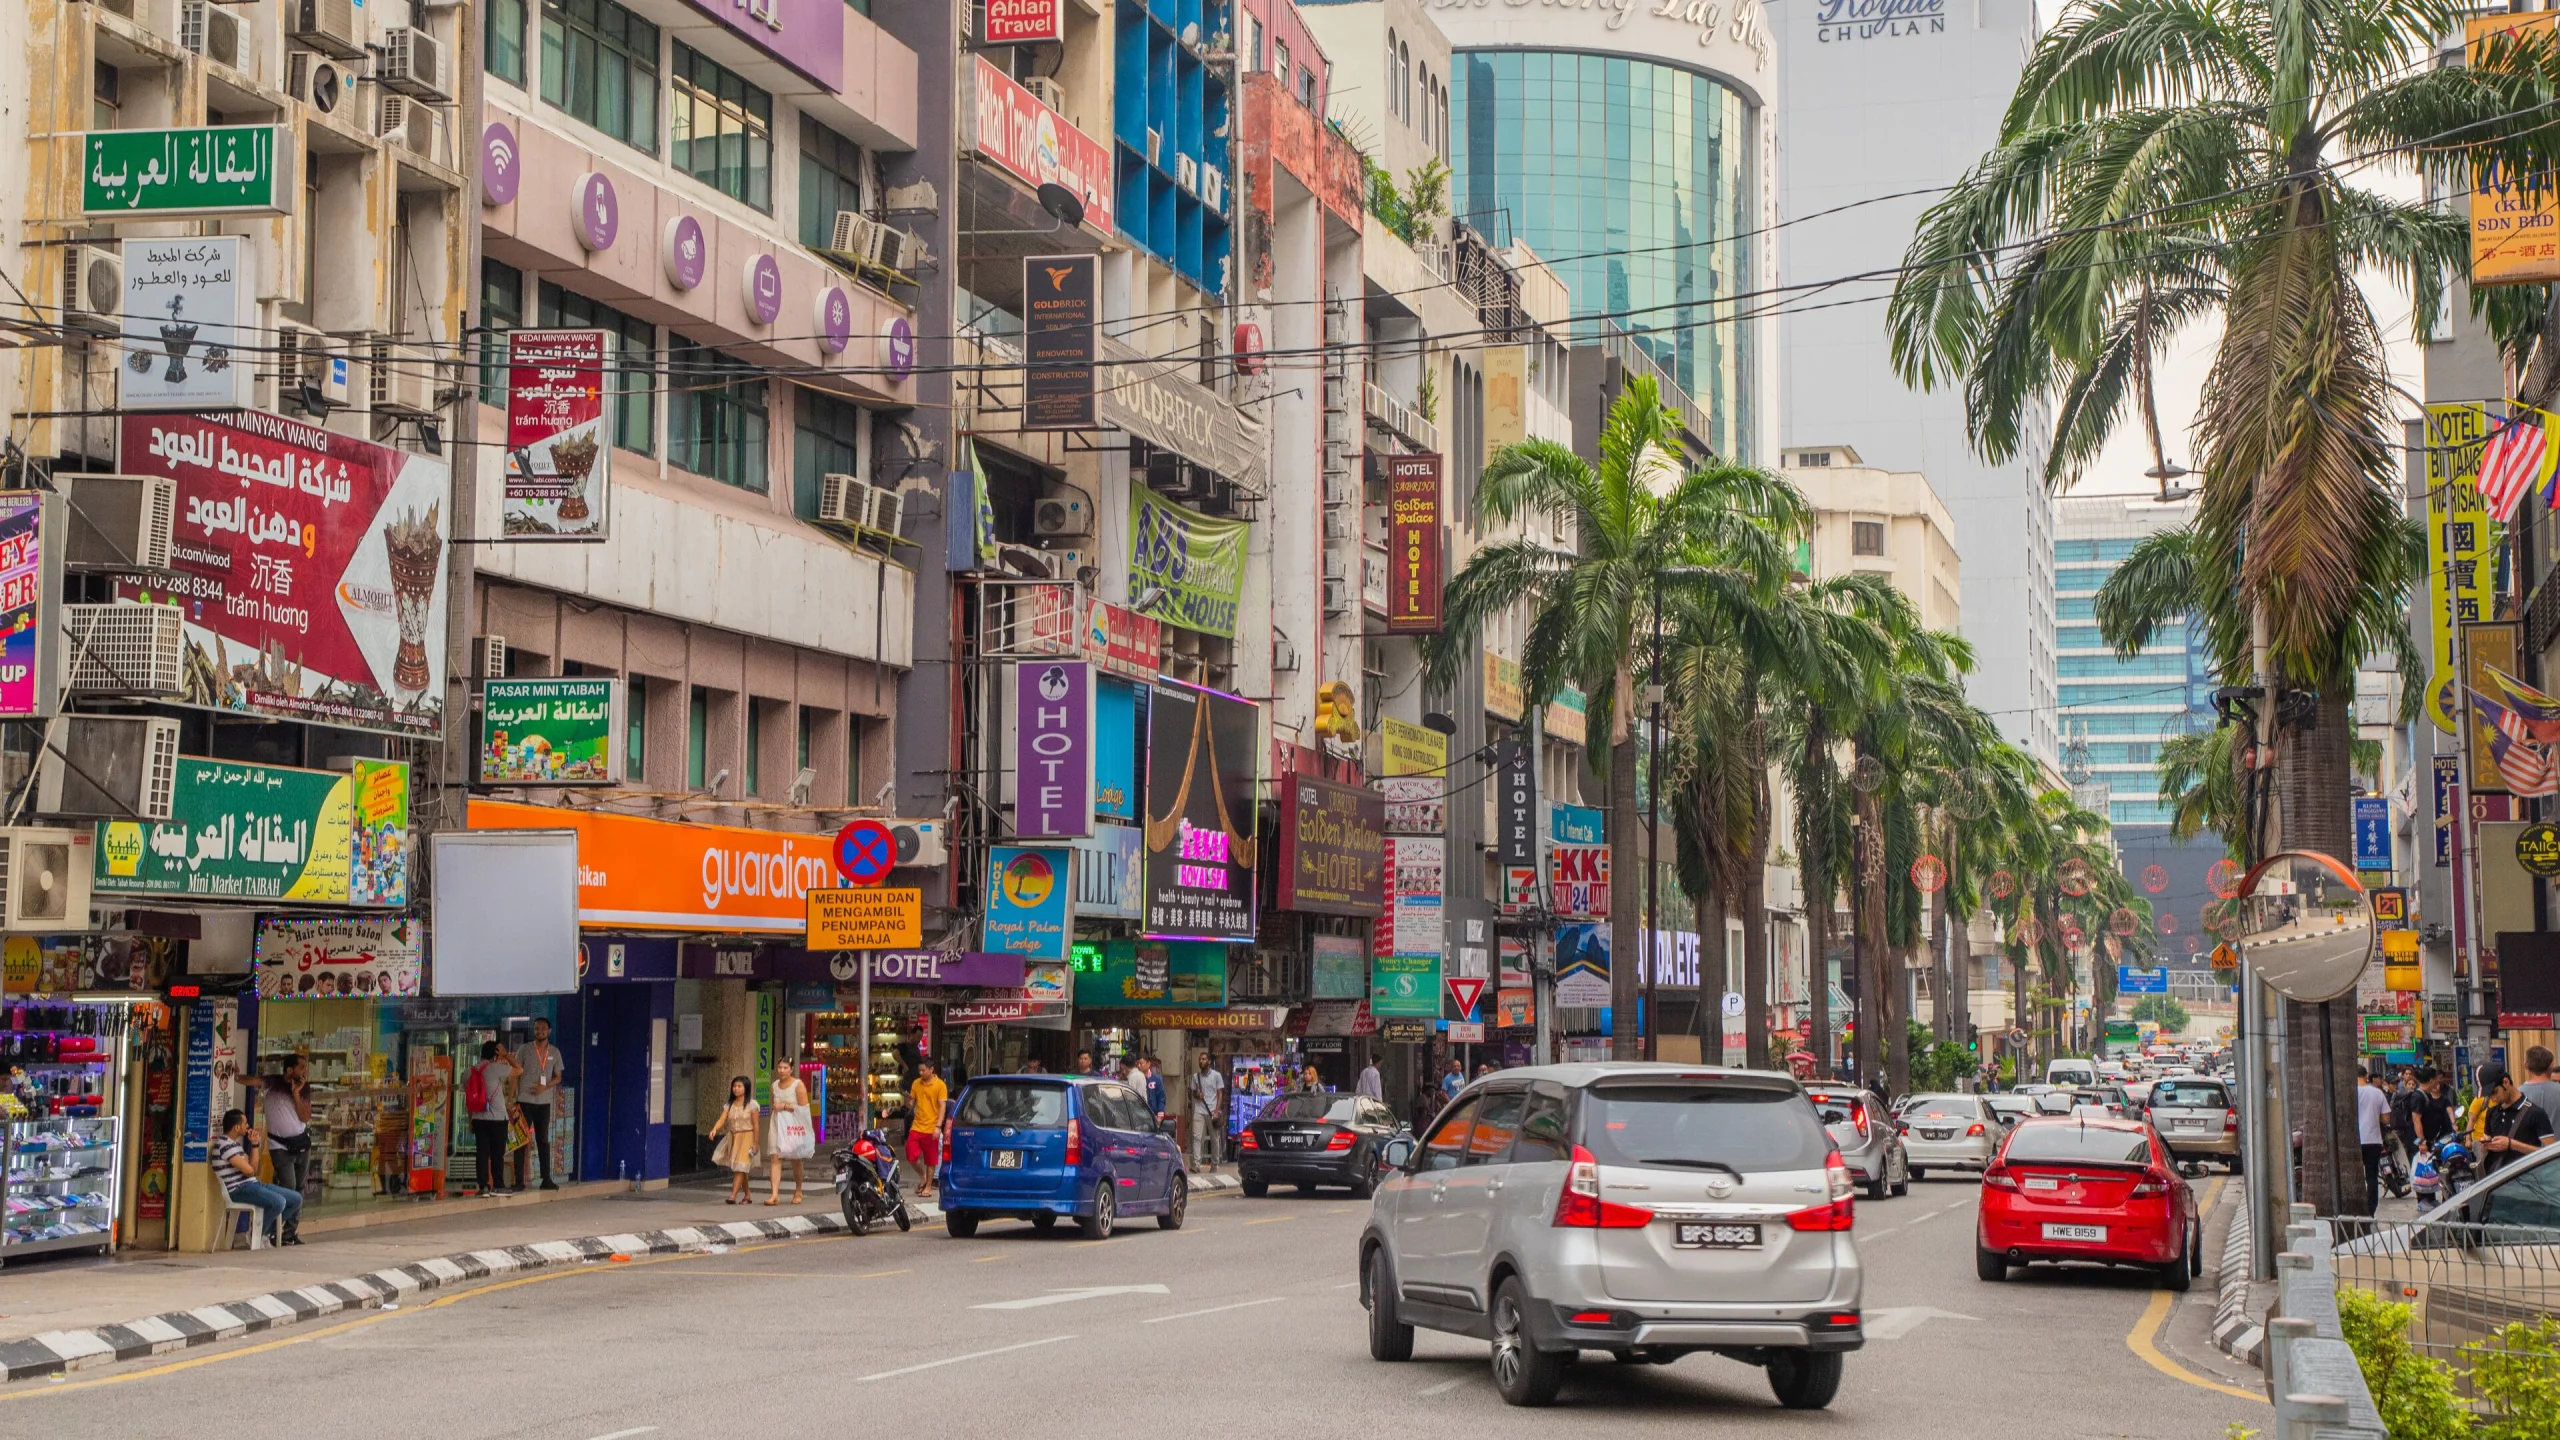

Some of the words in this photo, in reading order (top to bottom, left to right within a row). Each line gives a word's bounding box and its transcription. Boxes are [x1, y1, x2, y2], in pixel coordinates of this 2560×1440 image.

[991, 16, 1051, 34] Travel
[978, 67, 1005, 158] Ahlan
[1007, 86, 1038, 179] Travel
[92, 132, 178, 208] العربية
[189, 129, 265, 195] البقالة
[2477, 217, 2511, 231] SDN
[2518, 214, 2554, 229] BHD
[147, 247, 181, 266] المحيط
[184, 245, 221, 266] شركة
[2480, 243, 2556, 260] 第一酒店
[192, 269, 231, 289] للعود
[1034, 300, 1087, 309] GOLDBRICK
[1034, 312, 1086, 320] INTERNATIONAL
[519, 334, 540, 342] KEDAI
[542, 334, 570, 342] MINYAK
[1036, 350, 1084, 358] RENOVATION
[1031, 371, 1089, 380] CONSTRUCTION
[544, 400, 570, 414] 沉香
[1112, 364, 1214, 450] GOLDBRICK
[236, 411, 285, 441] MINYAK
[287, 423, 328, 453] WANGI
[2430, 411, 2480, 443] HOTEL
[149, 427, 214, 470] للعود
[217, 435, 295, 489] المحيط
[1396, 463, 1433, 476] HOTEL
[298, 458, 351, 508] شركة
[509, 489, 523, 497] +60
[550, 489, 568, 497] 8344
[1393, 481, 1435, 493] SABRINA
[1393, 499, 1435, 511] Golden
[186, 496, 246, 537] العود
[1395, 513, 1434, 527] Palace
[1132, 501, 1191, 584] ABS
[250, 552, 293, 597] 沉香
[1184, 556, 1236, 596] BINTANG
[1408, 529, 1421, 612] HOTEL
[193, 577, 223, 601] 8344
[351, 587, 394, 608] ALMOHIT
[263, 596, 309, 634] hương
[1182, 592, 1236, 632] HOUSE
[491, 685, 530, 697] PASAR
[532, 684, 559, 696] MINI
[561, 684, 605, 696] TAIBAH
[288, 696, 310, 710] Almohit
[310, 700, 330, 715] Trading
[487, 701, 548, 727] العربية
[553, 700, 609, 726] البقالة
[403, 715, 418, 726] LESEN
[1032, 706, 1072, 835] HOTEL
[2434, 760, 2457, 770] HOTE
[196, 766, 221, 787] الرحيم
[223, 769, 251, 786] الرحمن
[253, 770, 265, 784] الله
[267, 774, 283, 792] بسم
[1096, 780, 1126, 811] Lodge
[1300, 786, 1319, 806] HOTEL
[1513, 773, 1526, 857] HOTEL
[1298, 808, 1341, 847] Golden
[238, 811, 307, 878] البقالة
[702, 840, 827, 910] guardian
[1316, 852, 1365, 892] HOTEL
[1561, 849, 1601, 881] KK
[187, 873, 209, 893] Mini
[211, 875, 242, 895] Market
[244, 877, 280, 896] TAIBAH
[991, 861, 1003, 909] HOTEL
[815, 893, 882, 904] MENURUN
[887, 892, 914, 903] DAN
[1158, 888, 1176, 903] health
[1181, 890, 1200, 908] beauty
[1204, 893, 1215, 906] nail
[1220, 894, 1242, 910] eyebrow
[1572, 886, 1589, 912] 24
[1590, 885, 1607, 912] JAM
[2381, 899, 2397, 914] 21
[823, 906, 905, 918] MENGAMBIL
[294, 928, 315, 942] Hair
[317, 924, 353, 938] Cutting
[355, 925, 382, 942] Salon
[822, 919, 906, 932] PENUMPANG
[989, 920, 1025, 937] Royal
[1028, 920, 1062, 933] Palm
[838, 934, 891, 945] SAHAJA
[1005, 937, 1042, 953] Lodge
[1071, 945, 1095, 955] TOWN
[714, 951, 754, 976] HOTEL
[868, 953, 941, 979] HOTEL
[1377, 957, 1401, 967] Money
[1402, 958, 1432, 967] Changer
[994, 988, 1008, 998] Sdn
[1010, 988, 1024, 999] Bhd
[1169, 1013, 1215, 1027] Palace
[1217, 1013, 1265, 1026] HOTEL
[760, 994, 769, 1070] ABS
[997, 1159, 1015, 1168] 4424
[1680, 1225, 1713, 1242] BPS
[2052, 1226, 2072, 1236] HWE
[2074, 1227, 2097, 1238] 8159
